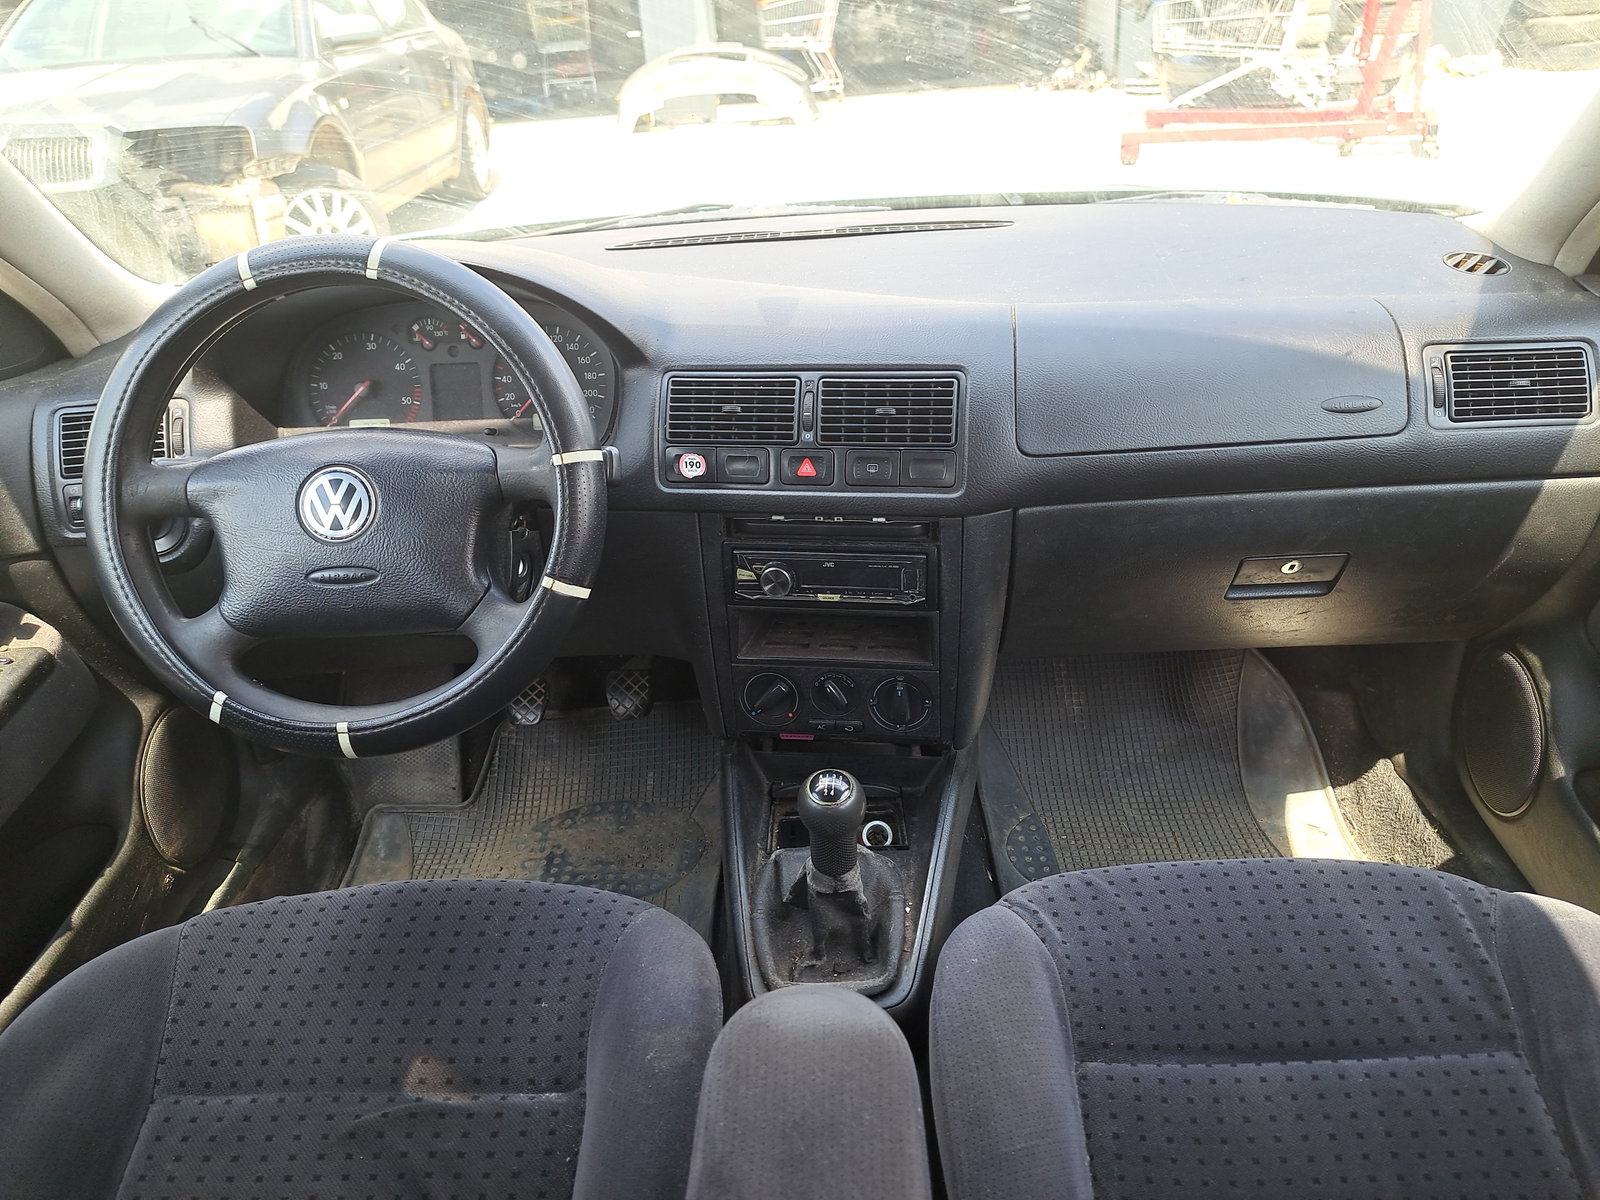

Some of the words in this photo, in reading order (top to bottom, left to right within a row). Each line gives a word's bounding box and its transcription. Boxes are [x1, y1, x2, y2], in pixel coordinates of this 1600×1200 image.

[366, 342, 377, 350] 30
[566, 343, 579, 351] 140
[332, 352, 343, 360] 20
[577, 356, 591, 364] 160
[394, 363, 406, 371] 40
[584, 372, 597, 380] 180
[319, 382, 328, 390] 10
[401, 397, 412, 405] 50
[684, 460, 702, 469] 190
